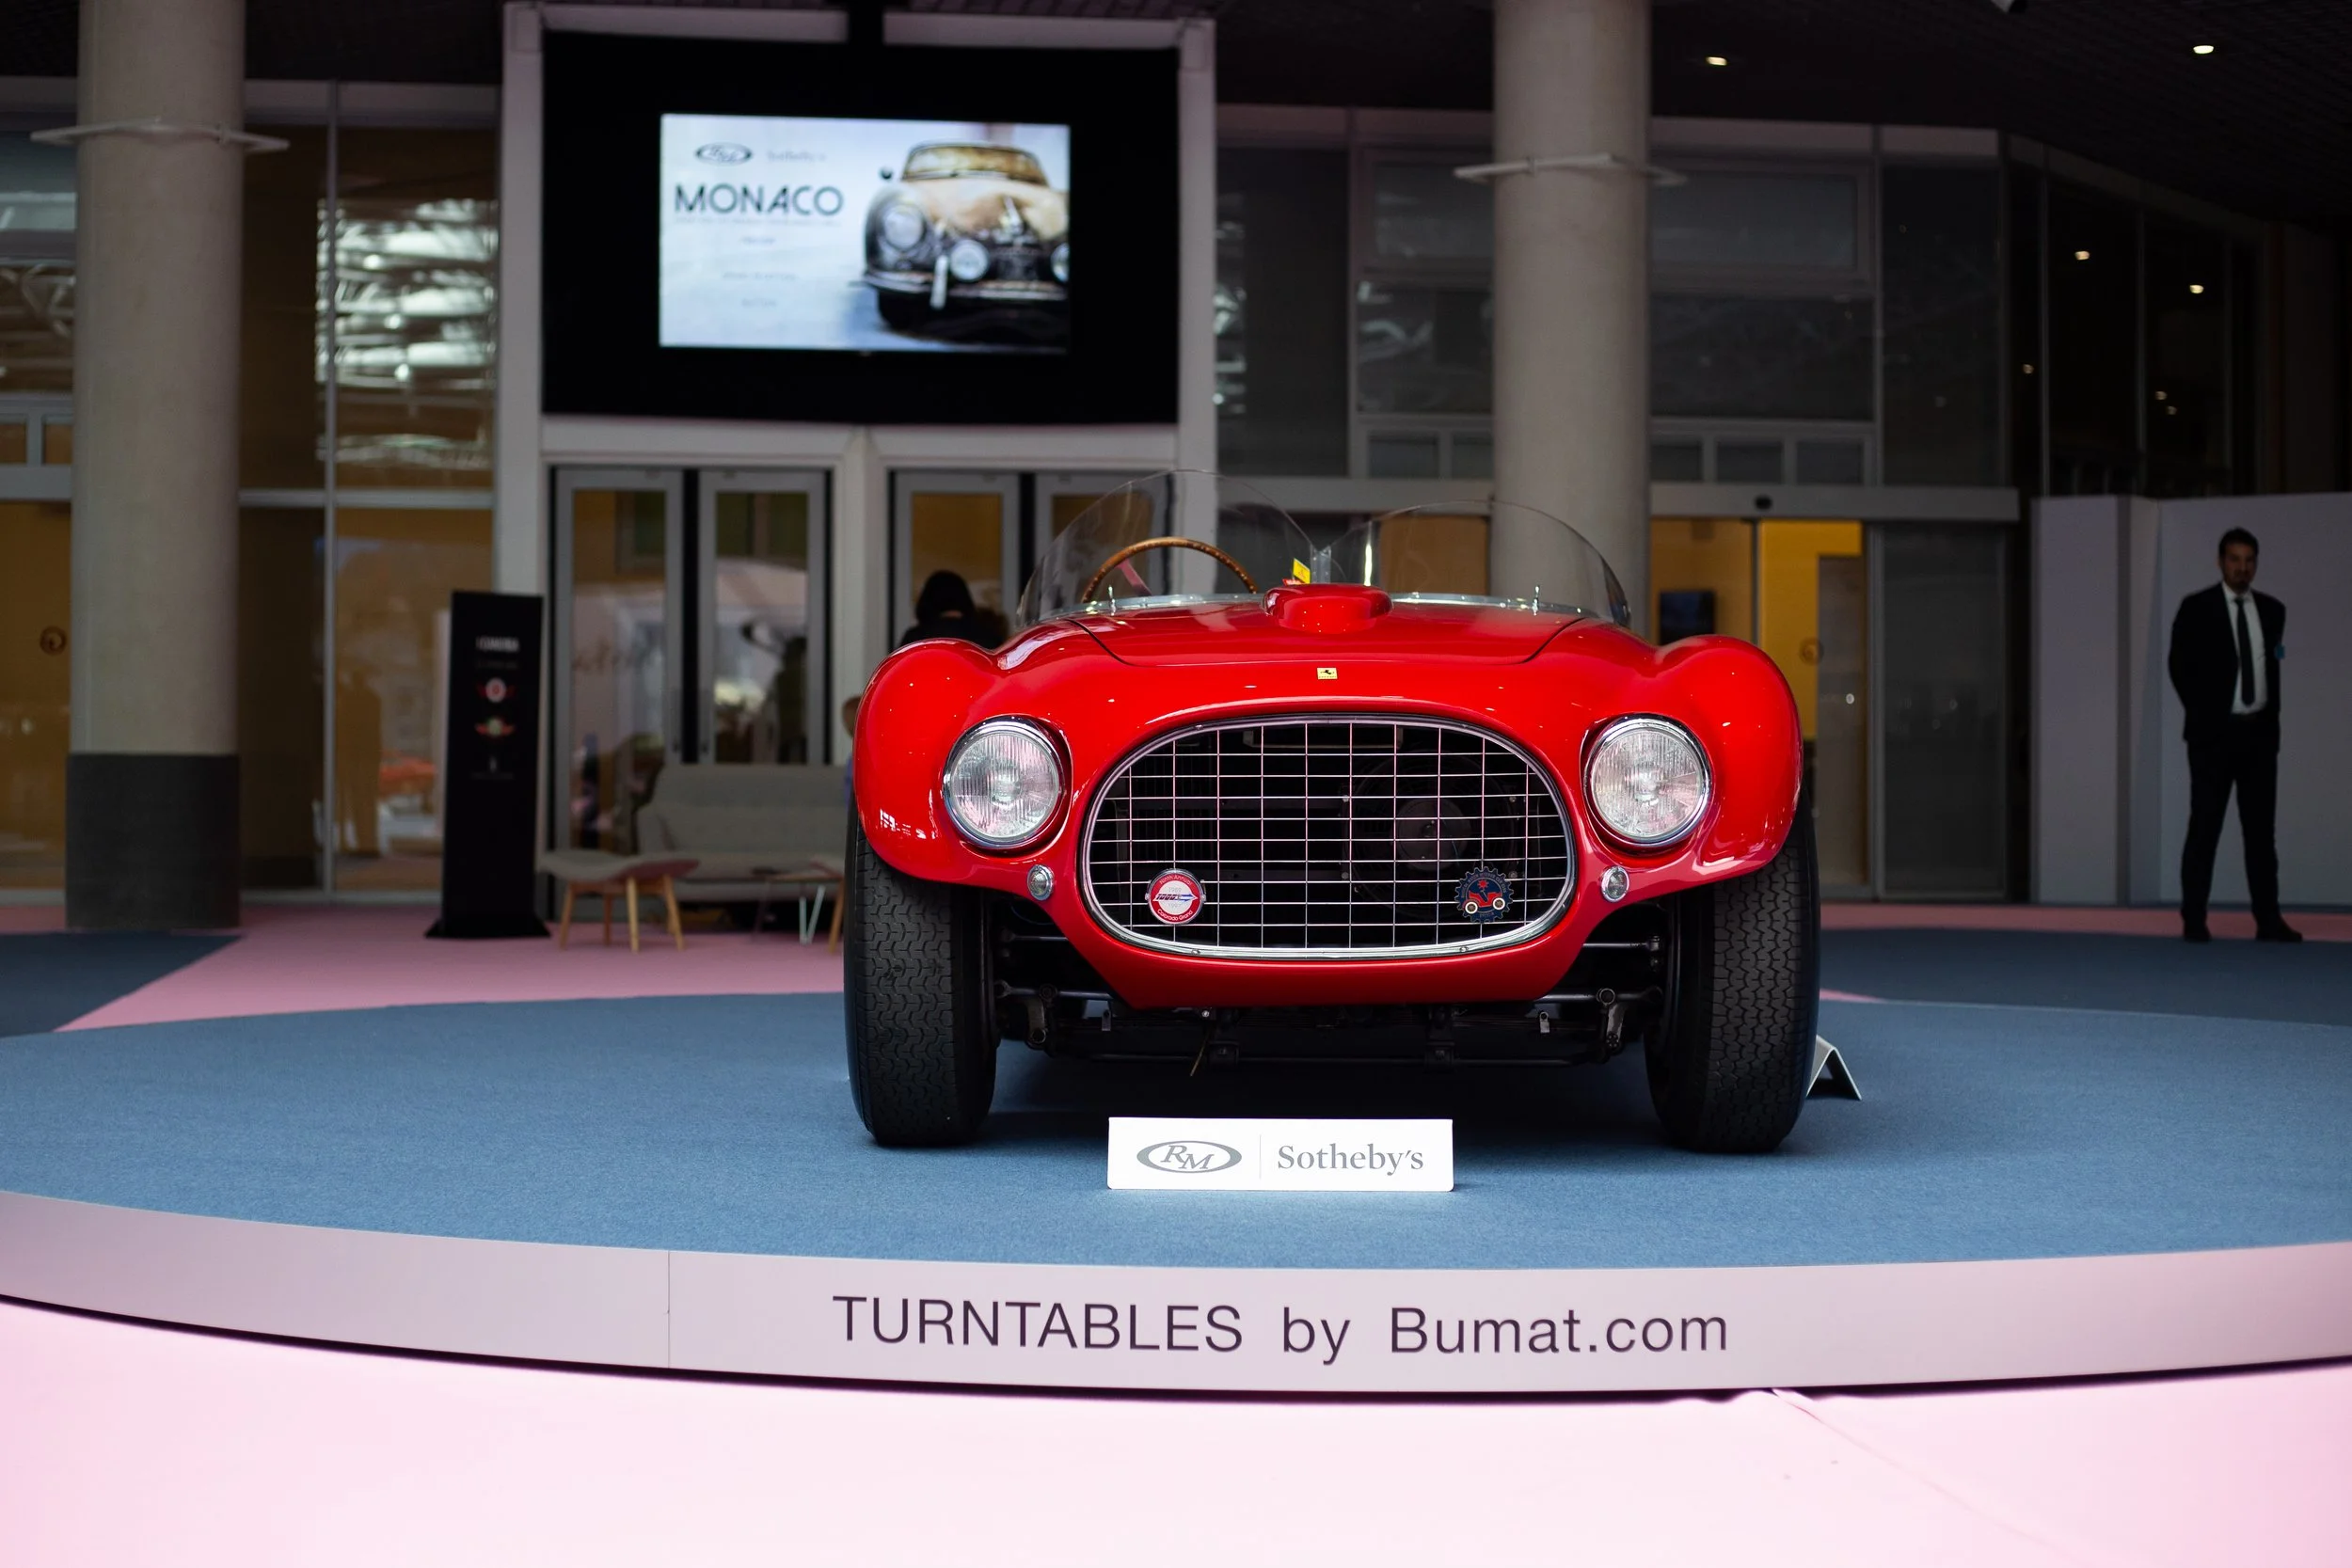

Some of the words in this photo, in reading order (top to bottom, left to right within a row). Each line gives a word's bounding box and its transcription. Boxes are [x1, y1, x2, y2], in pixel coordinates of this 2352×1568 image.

[675, 183, 845, 216] MONACO
[1157, 909, 1178, 921] Colorado
[1160, 1145, 1215, 1170] RM
[1278, 1143, 1424, 1176] Sotheby's
[832, 1295, 1243, 1353] TURNTABLES
[1283, 1307, 1351, 1365] by
[1391, 1307, 1726, 1354] Bumat.com
